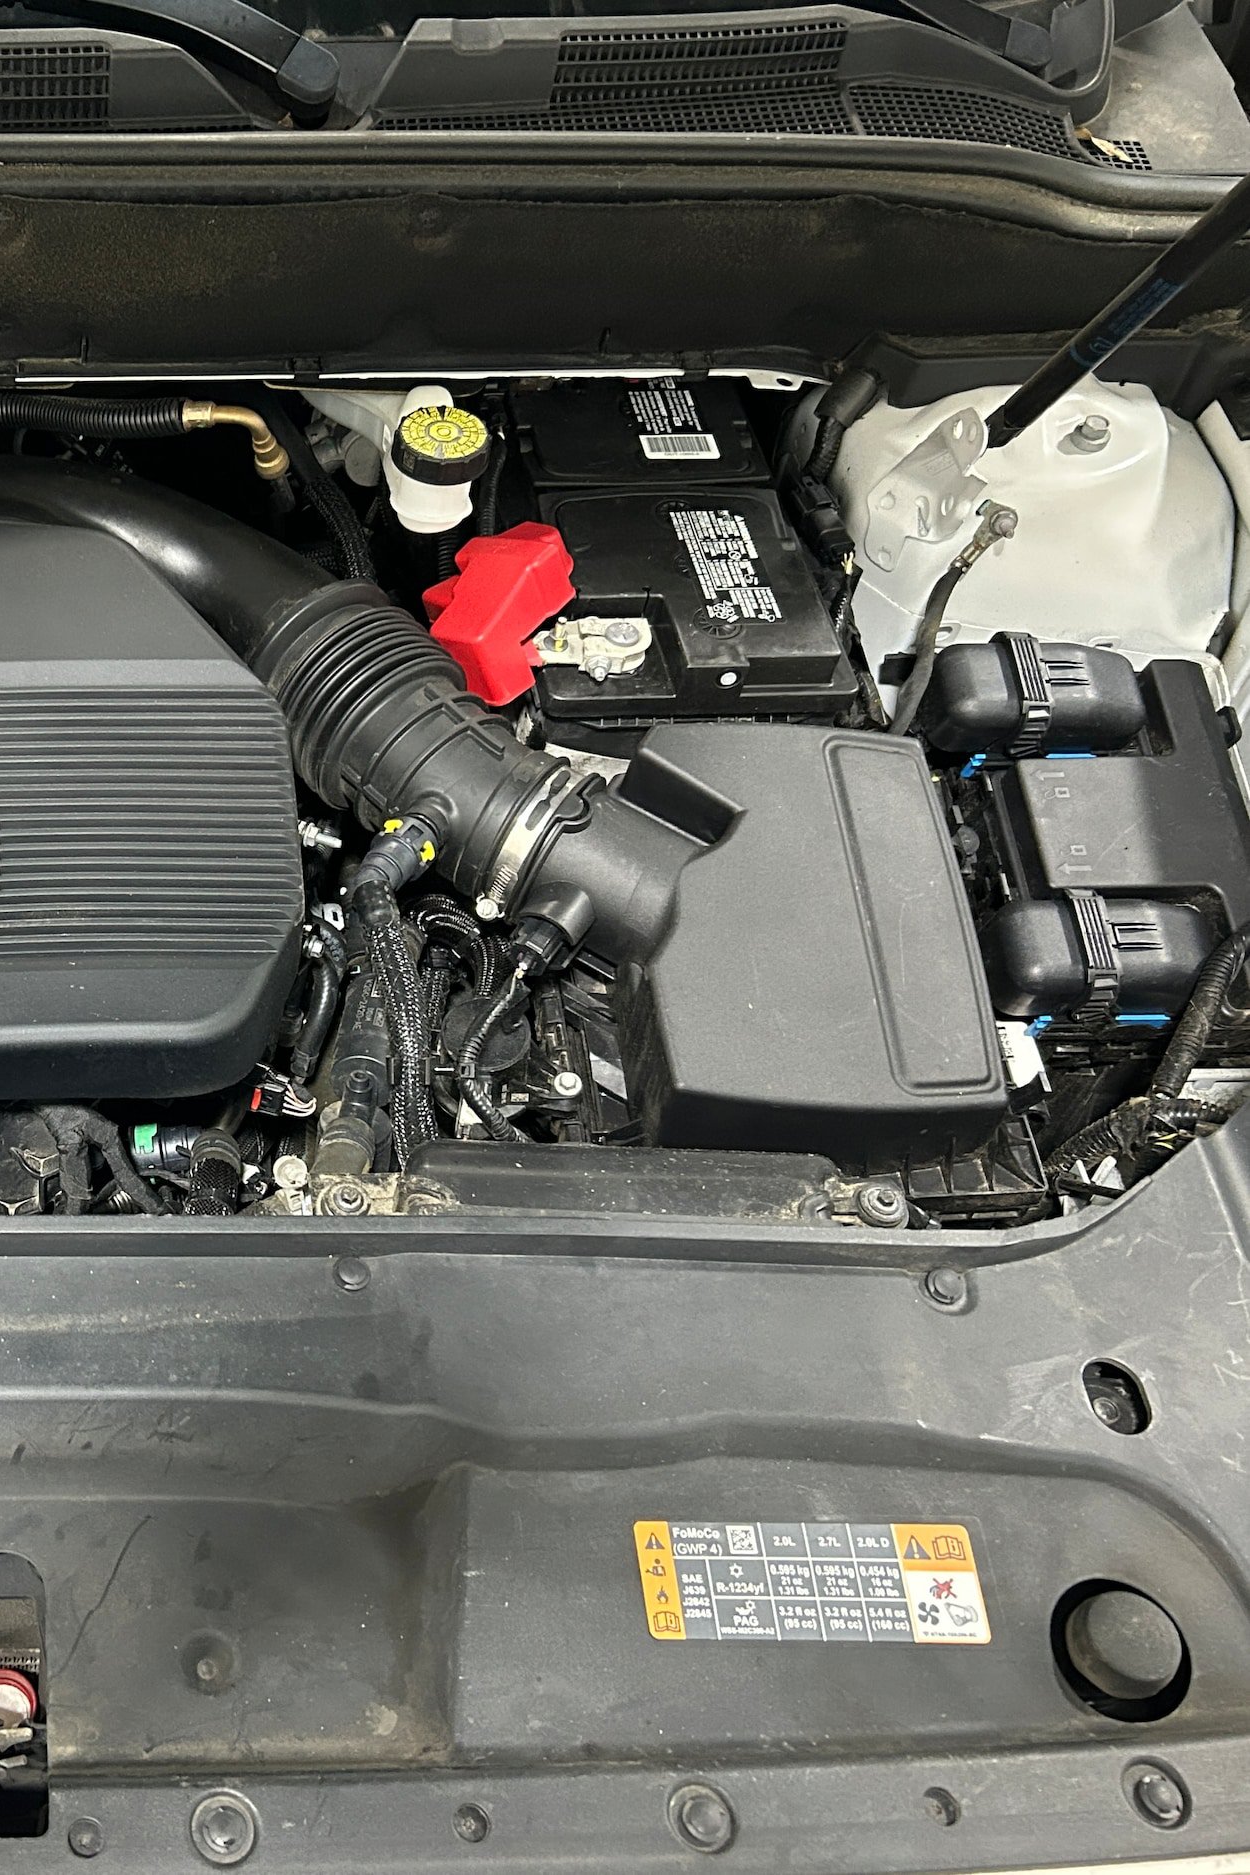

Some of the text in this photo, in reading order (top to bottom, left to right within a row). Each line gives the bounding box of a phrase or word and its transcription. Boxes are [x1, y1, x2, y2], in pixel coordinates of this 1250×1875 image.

[672, 1528, 720, 1540] FoMoCo
[772, 1536, 796, 1547] 2.0L
[817, 1536, 842, 1548] 2.7L
[880, 1537, 890, 1548] D
[672, 1543, 722, 1556] (GWP 4)
[797, 1564, 810, 1578] kg
[842, 1565, 855, 1578] kg
[886, 1566, 900, 1579] kg
[681, 1574, 704, 1584] SAE
[780, 1576, 804, 1586] 21 oz
[838, 1578, 848, 1586] oz
[882, 1578, 894, 1587] oz
[778, 1606, 794, 1616] 3.2
[804, 1608, 818, 1616] oz
[824, 1606, 840, 1617] 3.2
[849, 1608, 862, 1618] oz
[894, 1609, 907, 1618] oz
[733, 1615, 760, 1627] PAG
[801, 1618, 818, 1630] cc)
[846, 1619, 863, 1632] cc)
[894, 1620, 910, 1632] cc)
